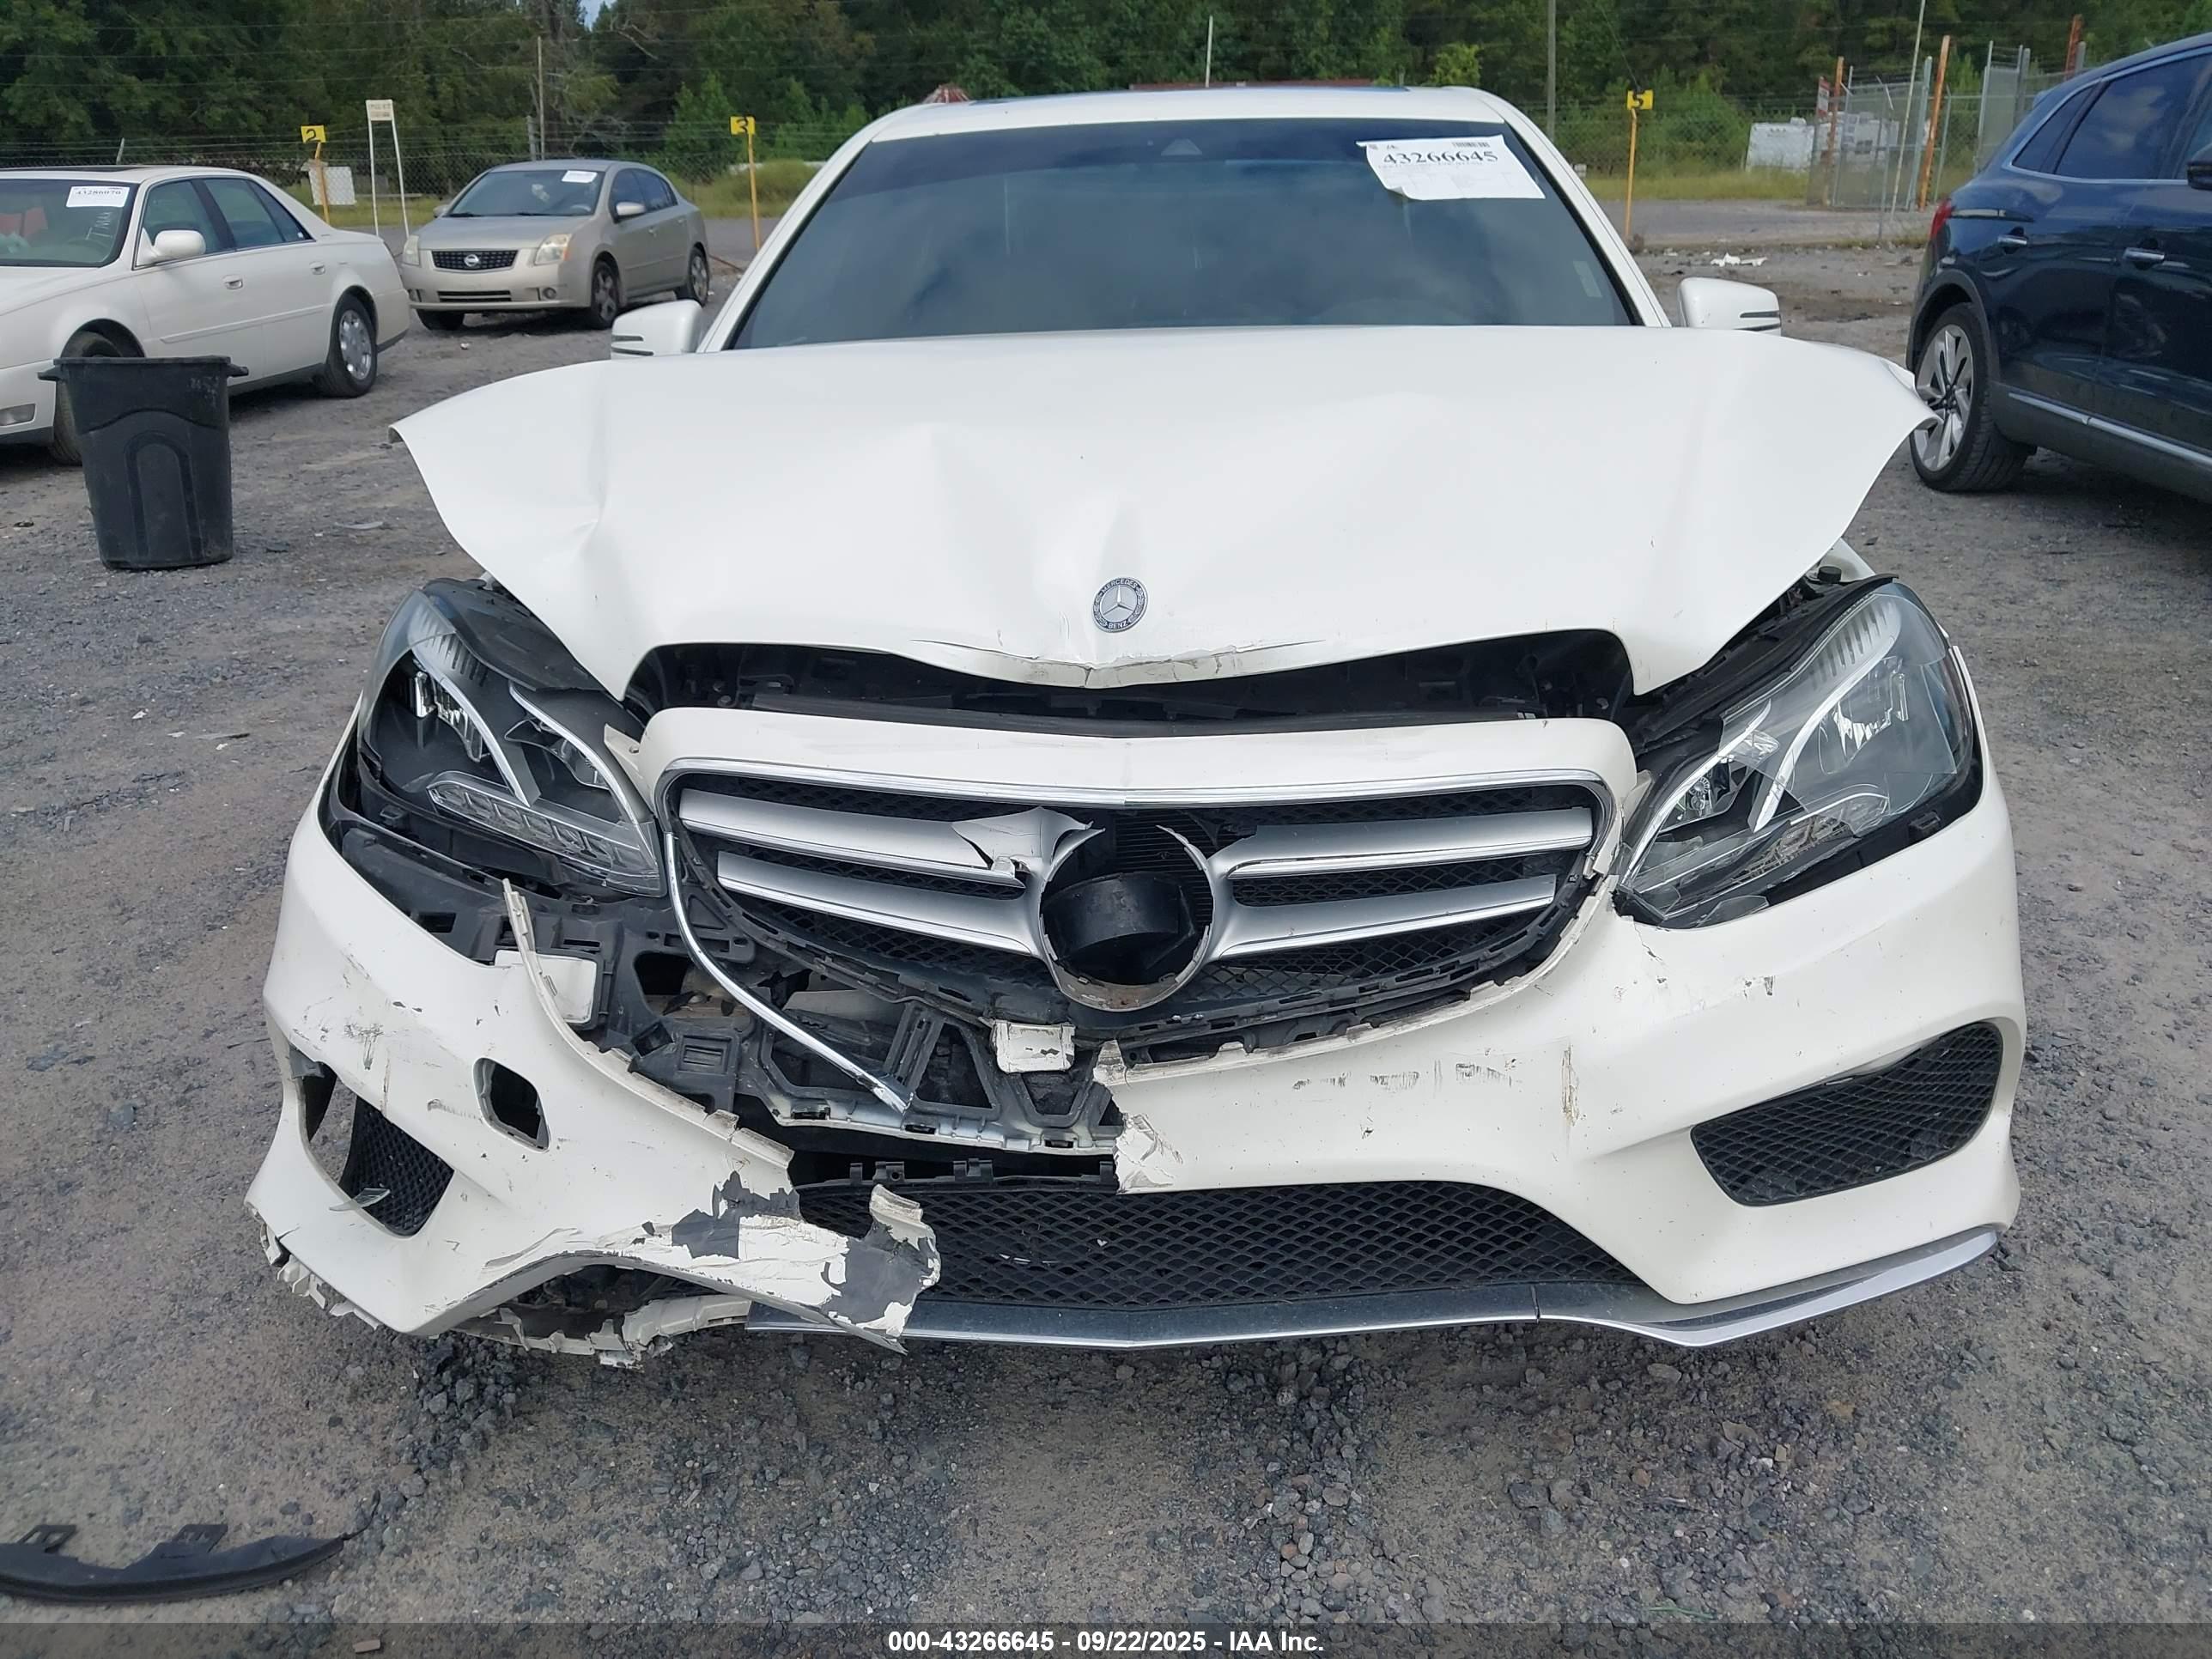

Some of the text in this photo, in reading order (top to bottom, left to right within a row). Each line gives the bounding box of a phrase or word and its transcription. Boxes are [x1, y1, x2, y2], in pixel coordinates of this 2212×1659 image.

[1632, 90, 1645, 109] 5
[736, 117, 749, 135] 3
[306, 128, 321, 143] 2
[1383, 150, 1498, 165] 43266645
[1102, 578, 1138, 593] MERCEDES
[1108, 619, 1128, 629] BENZ
